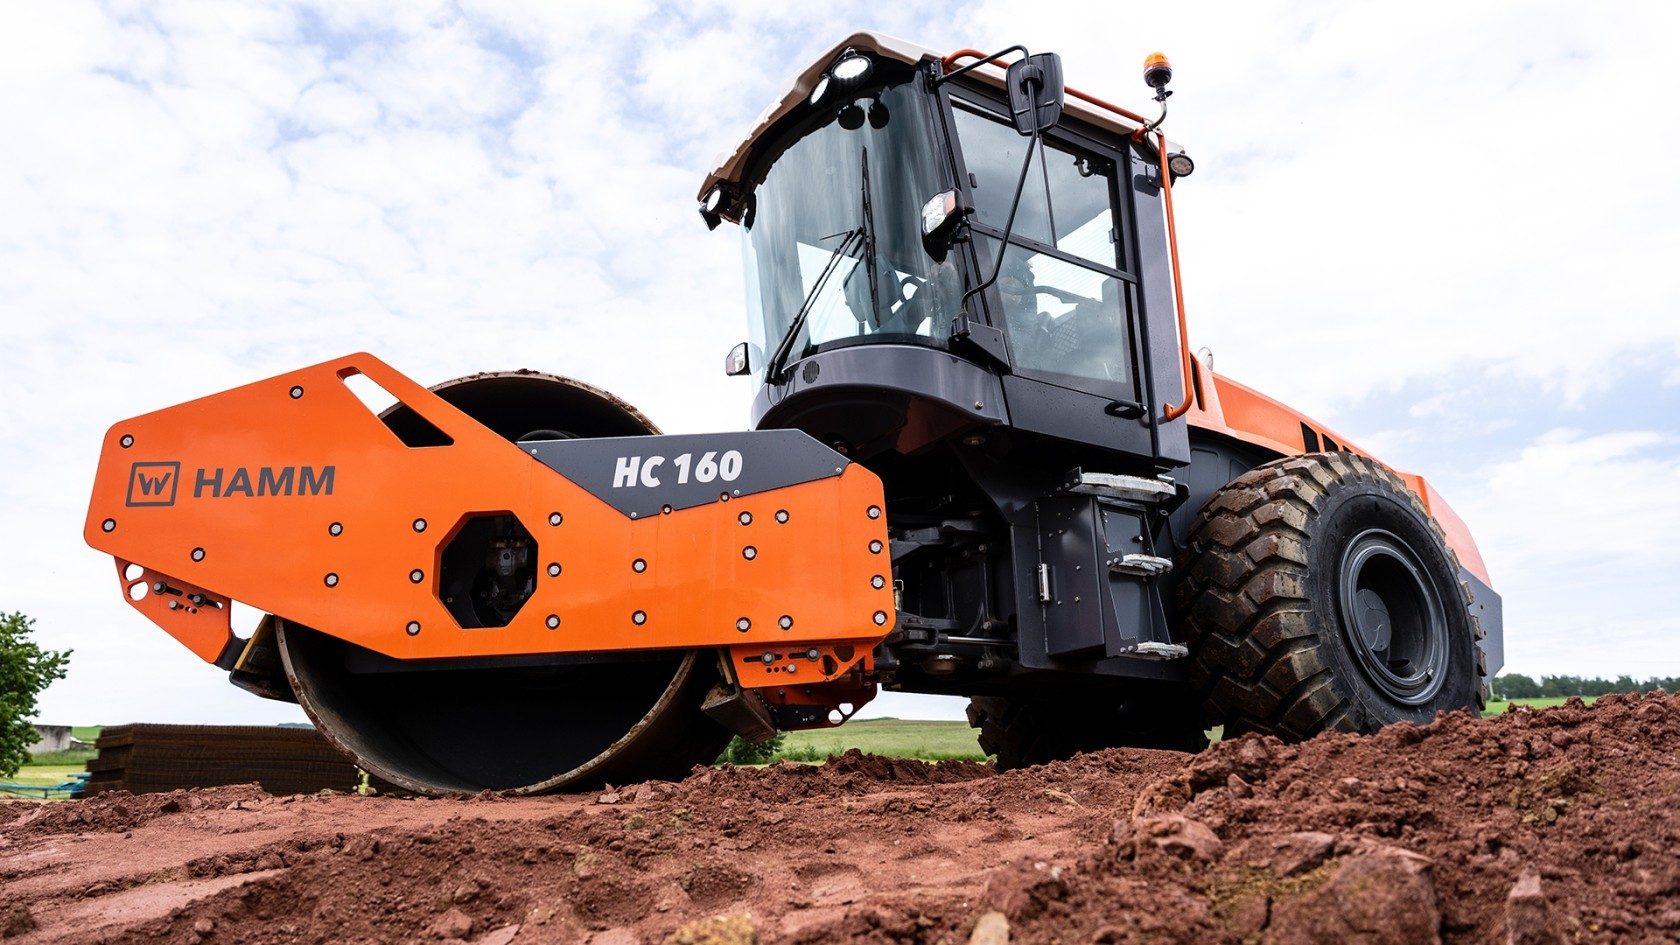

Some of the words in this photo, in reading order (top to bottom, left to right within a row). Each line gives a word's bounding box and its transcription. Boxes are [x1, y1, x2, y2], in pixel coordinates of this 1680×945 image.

[193, 466, 335, 497] HAMM
[612, 455, 666, 487] HC
[673, 450, 743, 484] 160
